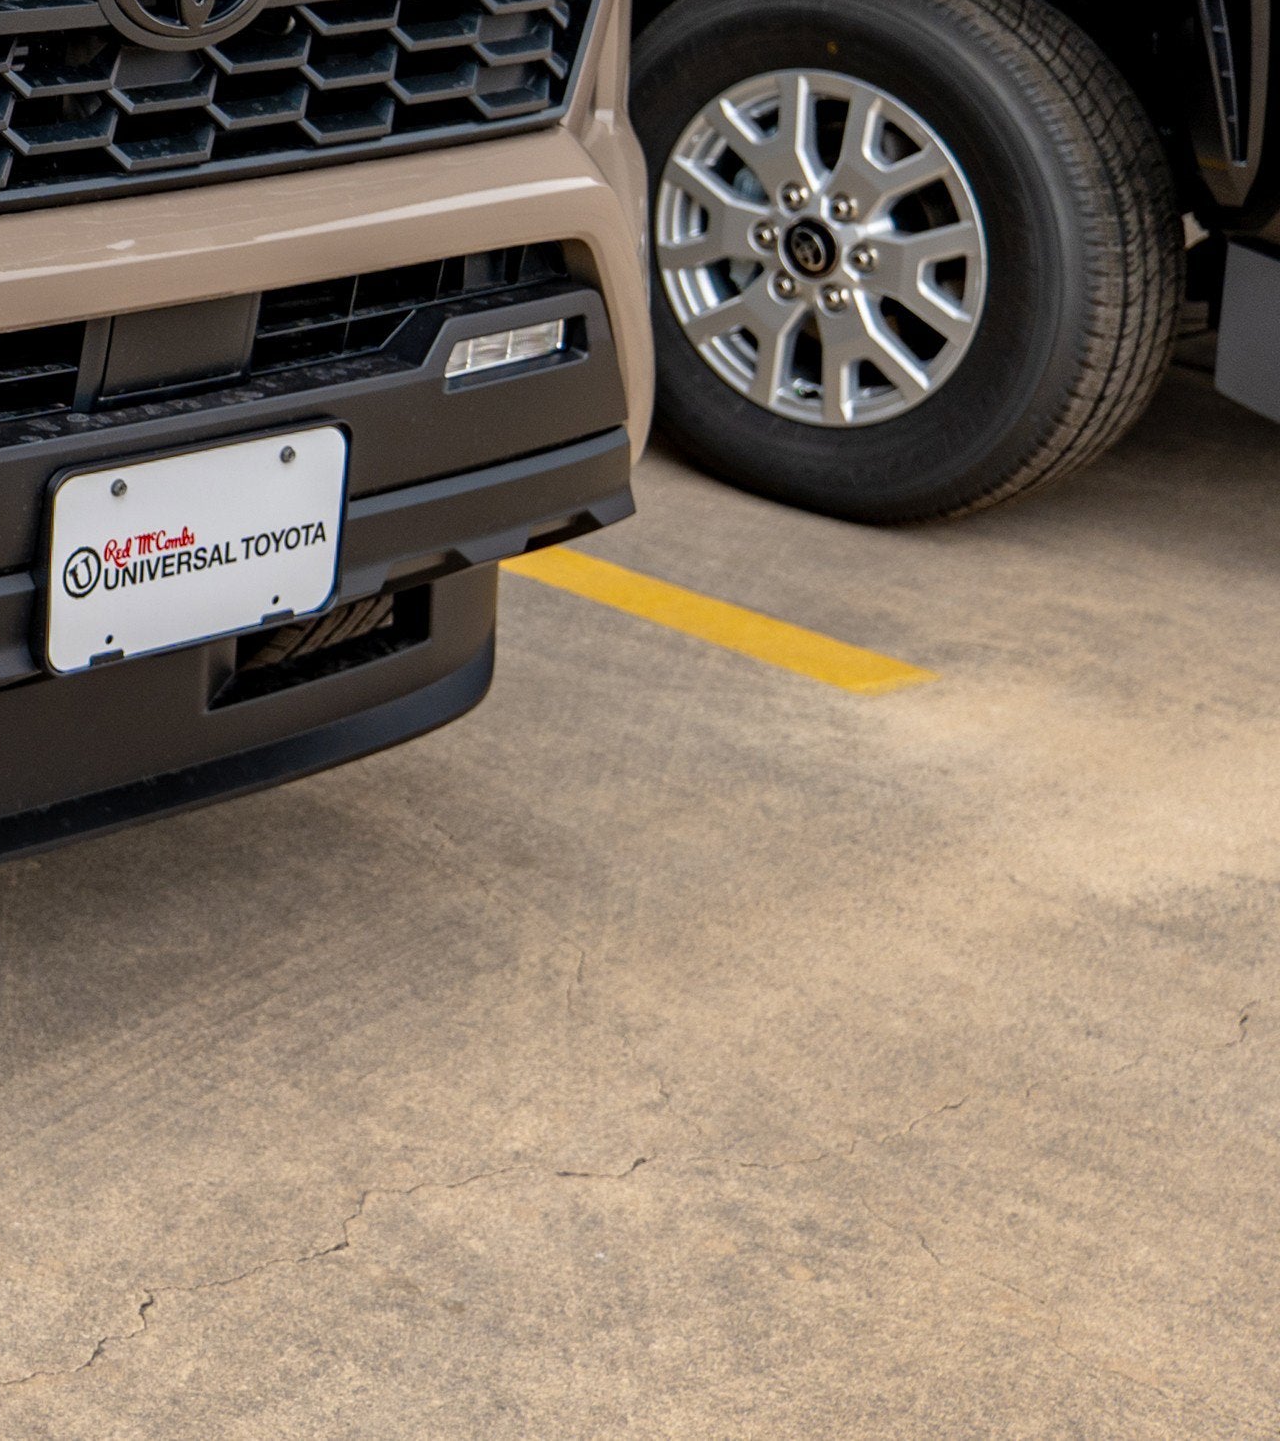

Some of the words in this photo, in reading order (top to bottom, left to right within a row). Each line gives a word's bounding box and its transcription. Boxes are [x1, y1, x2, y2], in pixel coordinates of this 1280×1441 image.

[103, 538, 133, 569] Red
[134, 525, 196, 555] McCombs
[103, 542, 237, 591] UNIVERSAL
[241, 521, 327, 561] TOYOTA
